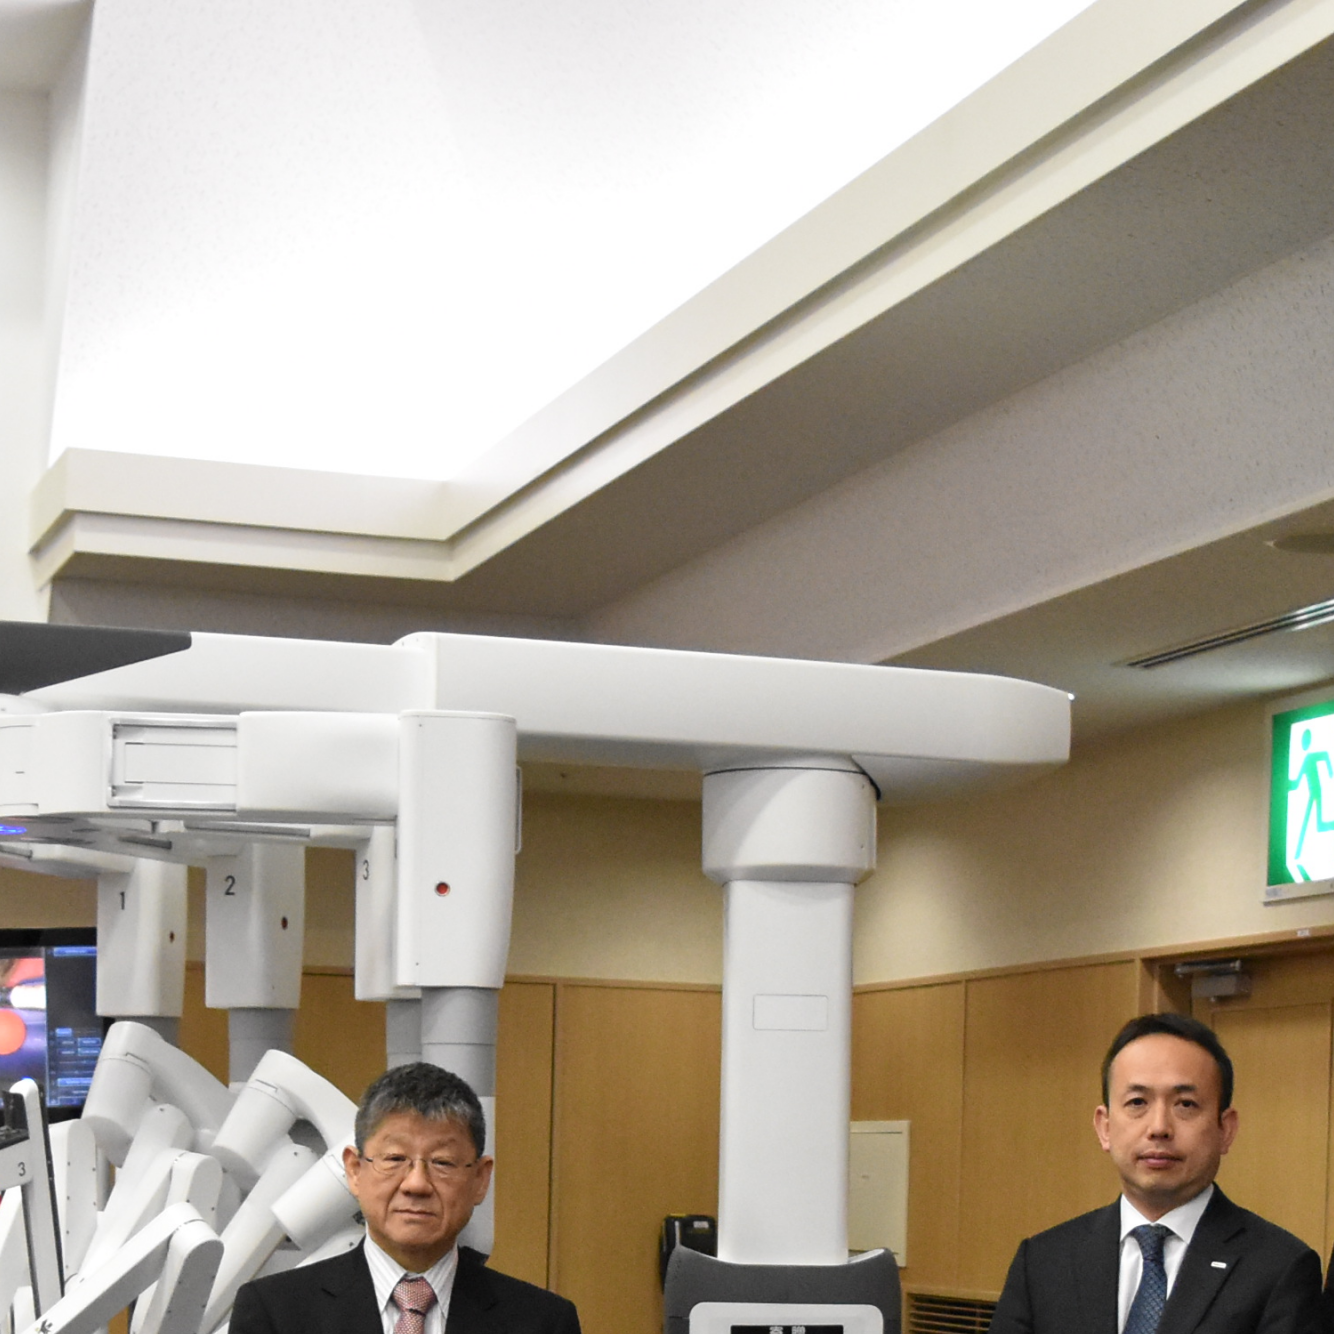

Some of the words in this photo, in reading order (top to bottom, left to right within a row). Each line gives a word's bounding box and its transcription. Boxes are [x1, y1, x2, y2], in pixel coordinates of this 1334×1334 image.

[362, 859, 370, 881] 3
[224, 875, 236, 896] 2
[119, 891, 126, 910] 1
[17, 1161, 27, 1177] 3
